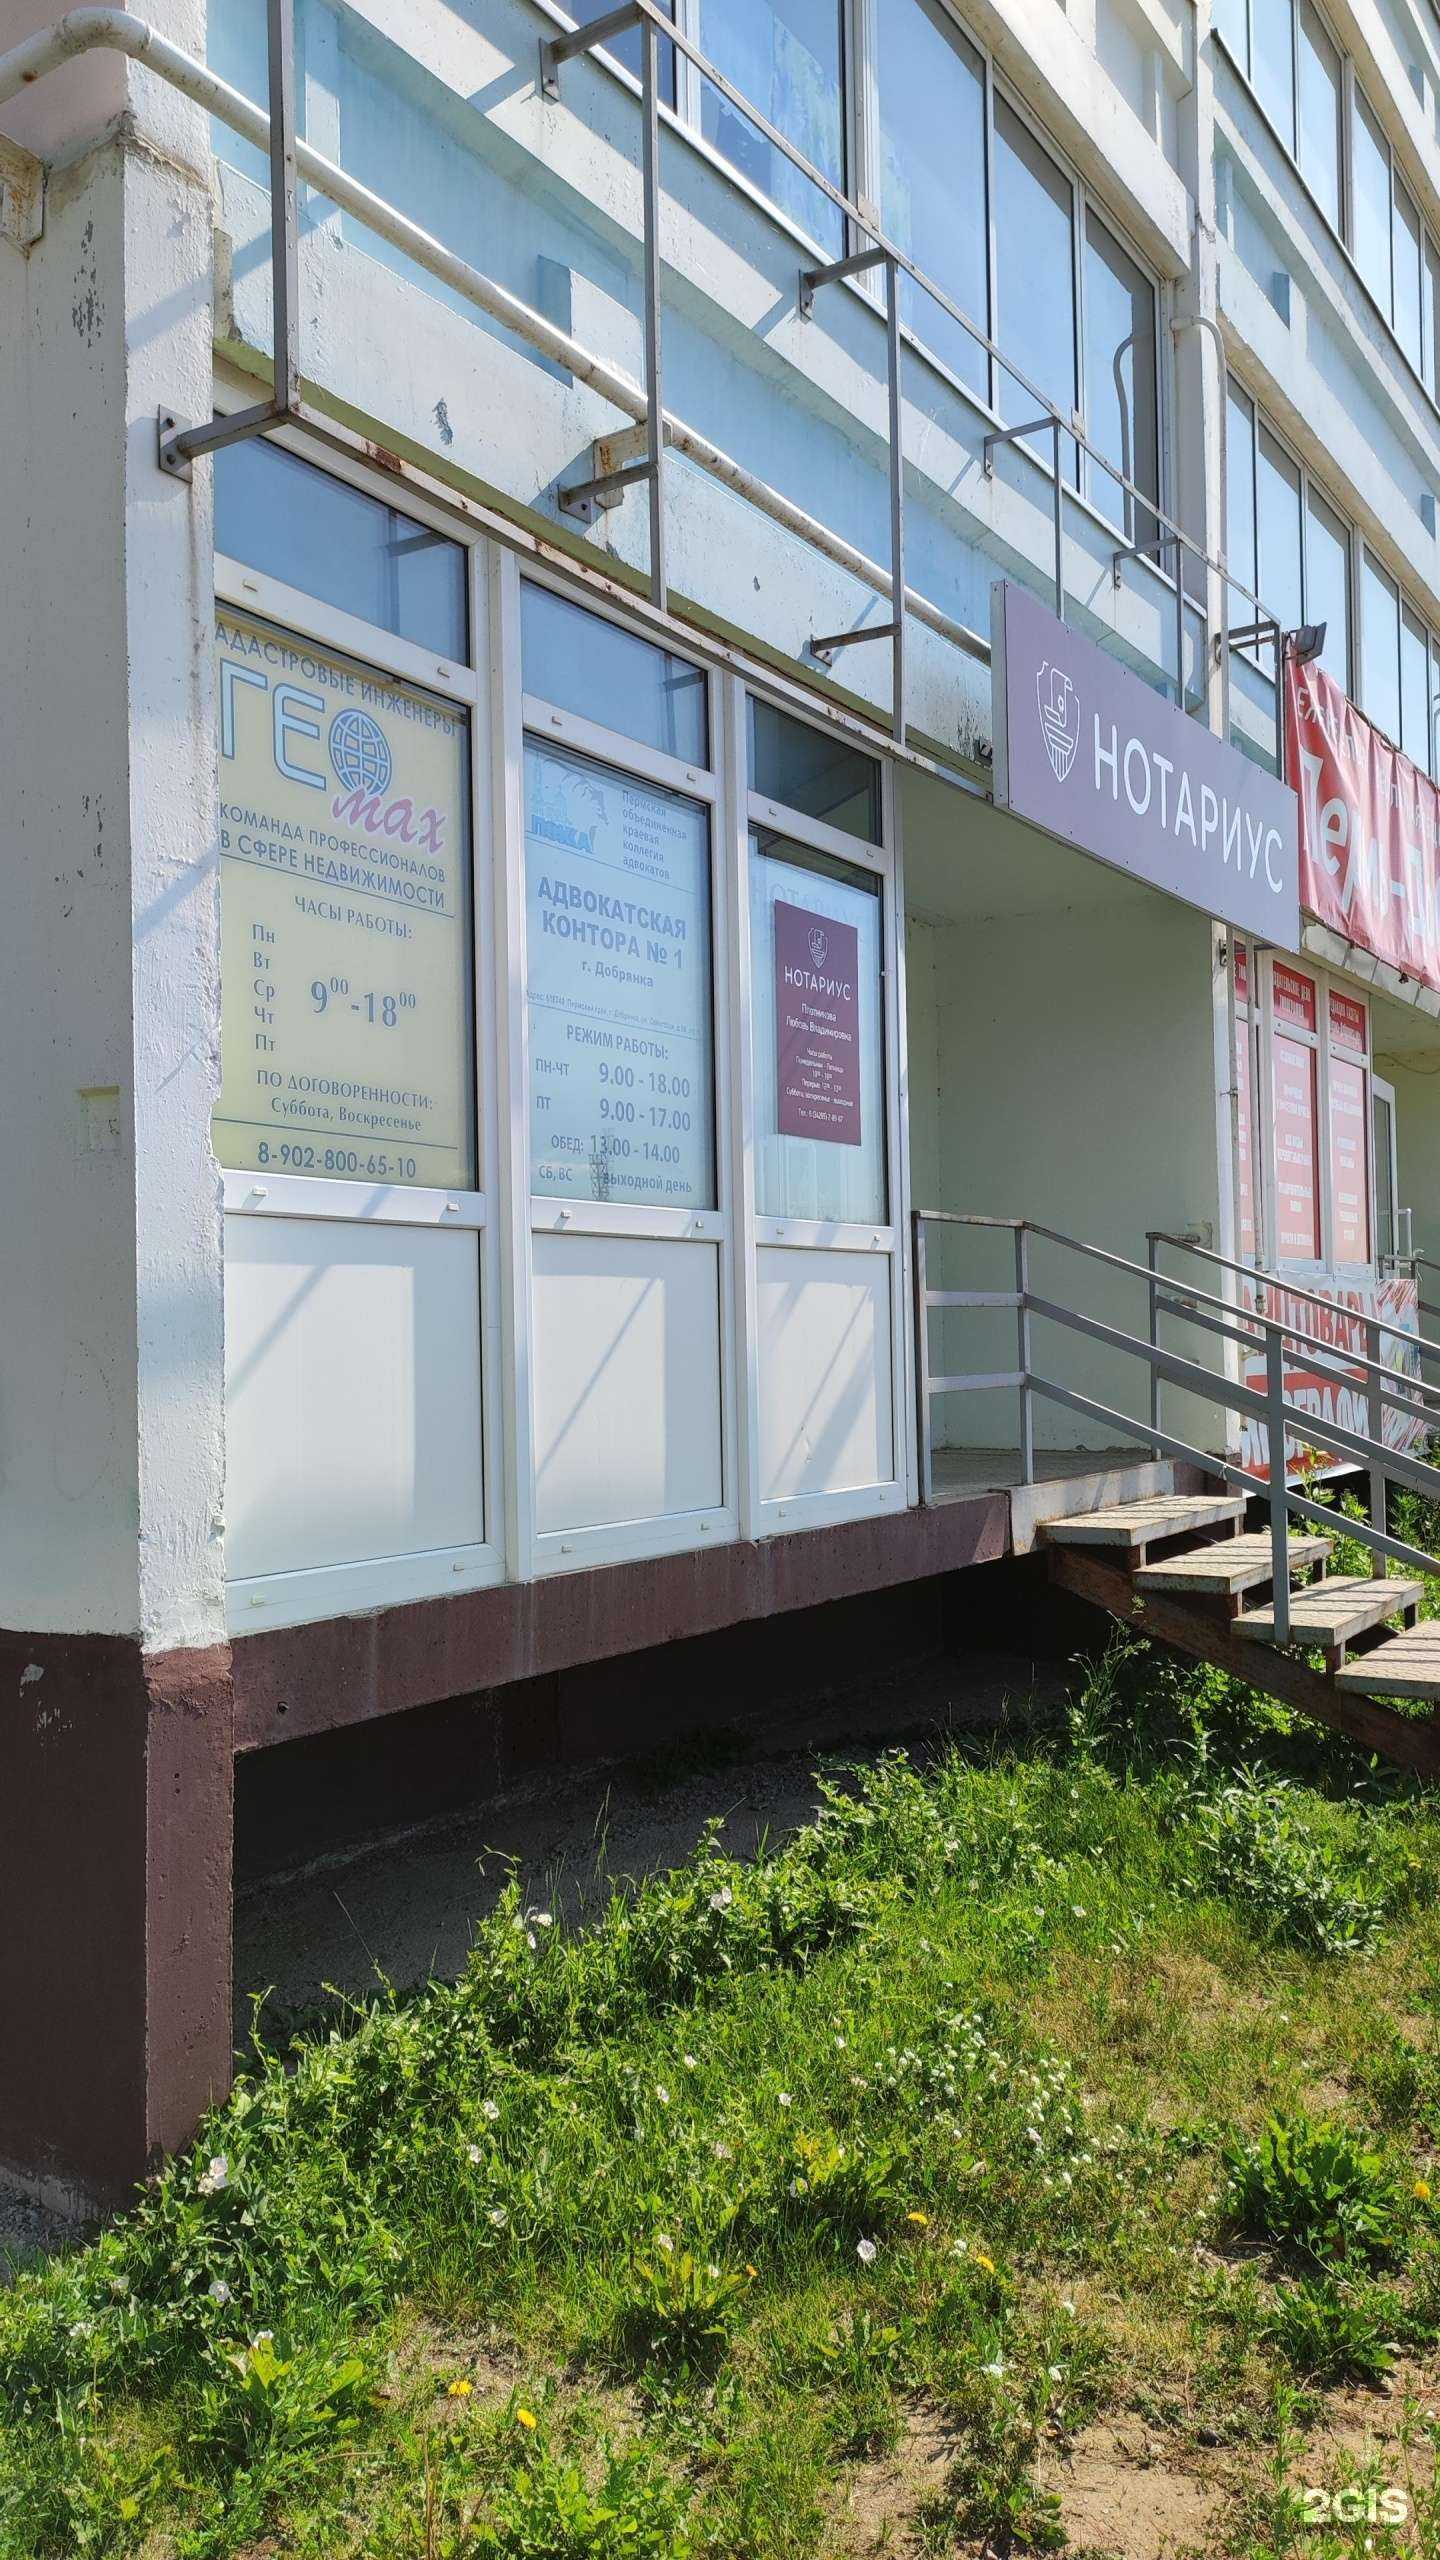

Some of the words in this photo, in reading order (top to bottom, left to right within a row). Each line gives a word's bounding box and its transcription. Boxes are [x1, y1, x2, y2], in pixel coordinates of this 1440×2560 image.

[214, 621, 355, 696] АДАСТРОВЫЕ
[361, 682, 456, 737] ИНЖЕНЕРЫ
[1093, 712, 1284, 894] НОТАРИУС
[220, 802, 303, 842] КОМАНДА
[309, 829, 446, 883] ПРОФЕССИОНАЛОВ
[622, 825, 660, 845] краевая
[622, 840, 664, 862] коллегия
[220, 829, 230, 849] В
[238, 835, 297, 869] СФЕРЕ
[304, 855, 444, 908] НЕДВИЖИМОСТИ
[622, 855, 670, 880] адвокатов
[295, 896, 341, 921] ЧАСЫ
[347, 909, 413, 939] РАБОТЫ:
[538, 875, 686, 940] АДВОКАТСКАЯ
[252, 924, 275, 943] Пн
[542, 910, 640, 959] КОНТОРА
[647, 941, 668, 965] №
[674, 949, 682, 969] 1
[253, 951, 270, 970] Вт
[582, 960, 591, 972] г.
[595, 961, 654, 988] Добрянка
[253, 979, 275, 1002] Ср
[784, 965, 851, 1001] НОТАРИУС
[254, 1006, 274, 1025] Чт
[255, 1034, 275, 1052] Пт
[567, 1023, 613, 1049] РЕЖИМ
[616, 1035, 668, 1060] РАБОТЫ:
[257, 1069, 282, 1087] ПО
[288, 1075, 433, 1110] ДОГОВОРЕННОСТИ:
[535, 1058, 570, 1076] ПН-ЧТ
[649, 1072, 690, 1098] 18.00
[271, 1096, 334, 1122] Суббота,
[339, 1106, 422, 1132] Воскресенье
[536, 1095, 551, 1111] ПТ
[649, 1107, 691, 1132] 17.00
[257, 1141, 416, 1179] 8-902-800-65-10
[551, 1135, 584, 1153] ОБЕД:
[643, 1142, 680, 1164] 14.00
[559, 1168, 573, 1182] ВС
[666, 1179, 692, 1195] день
